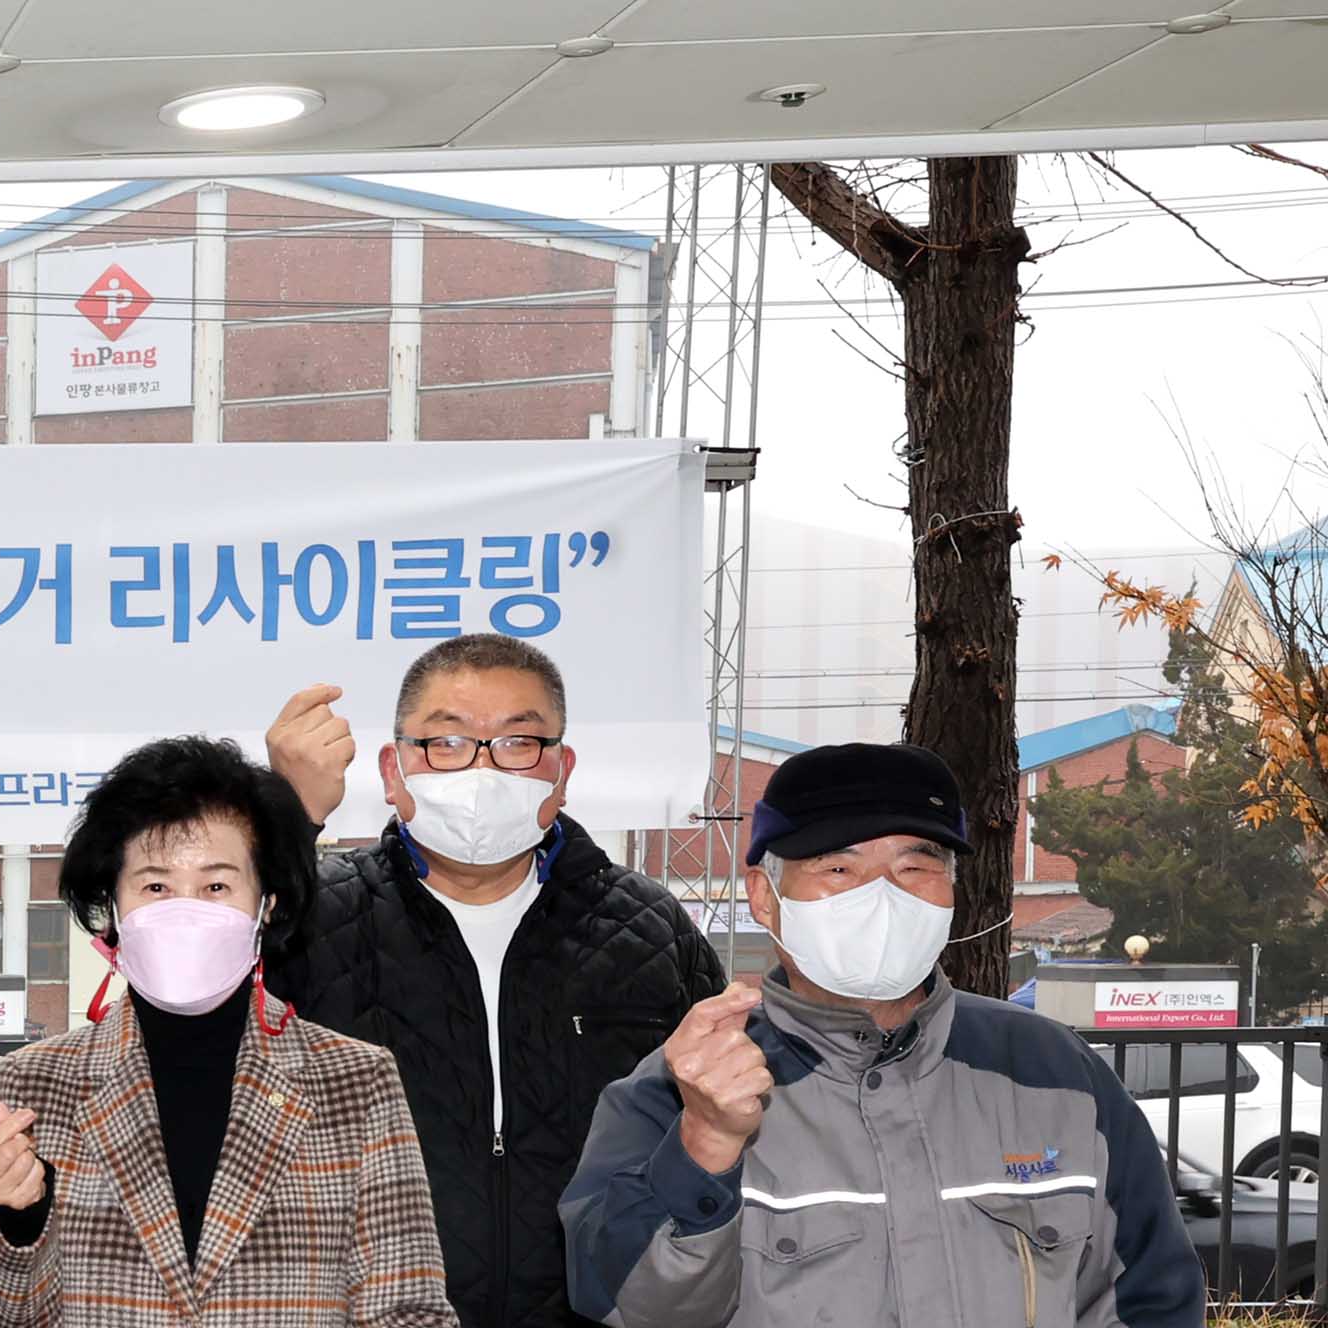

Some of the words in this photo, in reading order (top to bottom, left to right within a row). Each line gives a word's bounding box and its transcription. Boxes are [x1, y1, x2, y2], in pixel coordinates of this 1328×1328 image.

[70, 346, 157, 368] inPang
[108, 530, 610, 643] 리사이클링”
[1106, 1014, 1160, 1022] International
